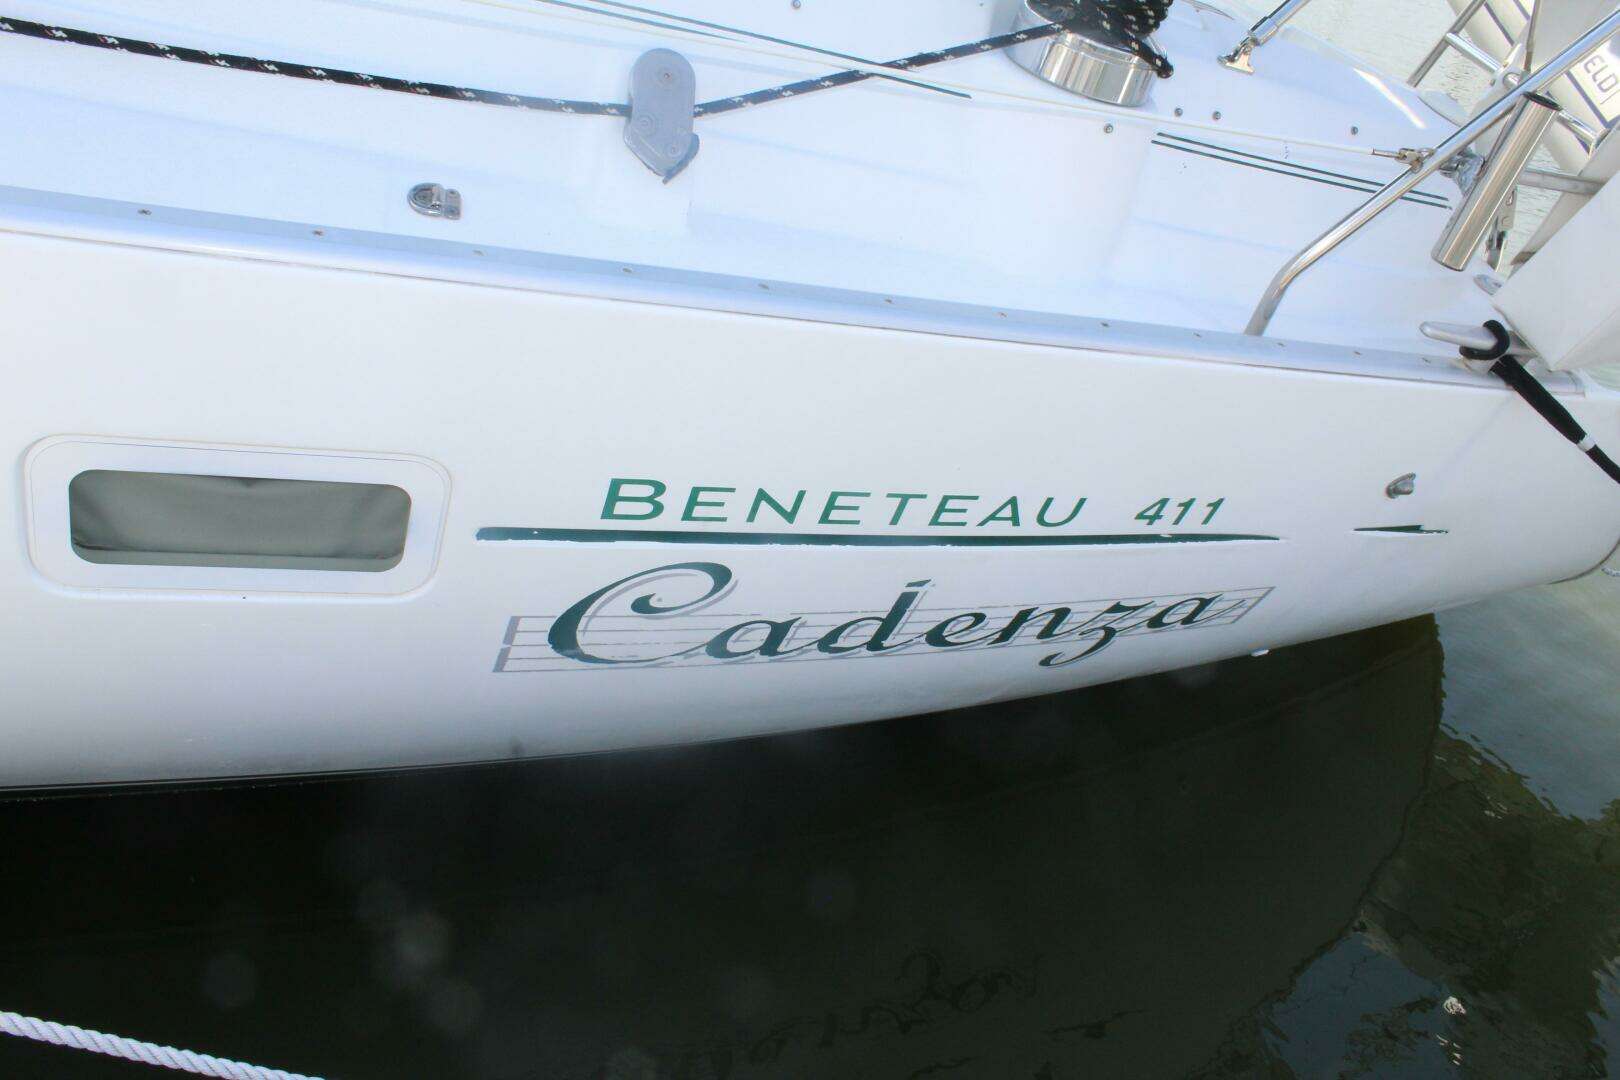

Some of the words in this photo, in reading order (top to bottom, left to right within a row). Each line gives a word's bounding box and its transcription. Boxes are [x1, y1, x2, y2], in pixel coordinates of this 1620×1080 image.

[600, 477, 1088, 527] BENETEAU
[1134, 497, 1226, 525] 411
[547, 561, 1245, 667] Cadenza
